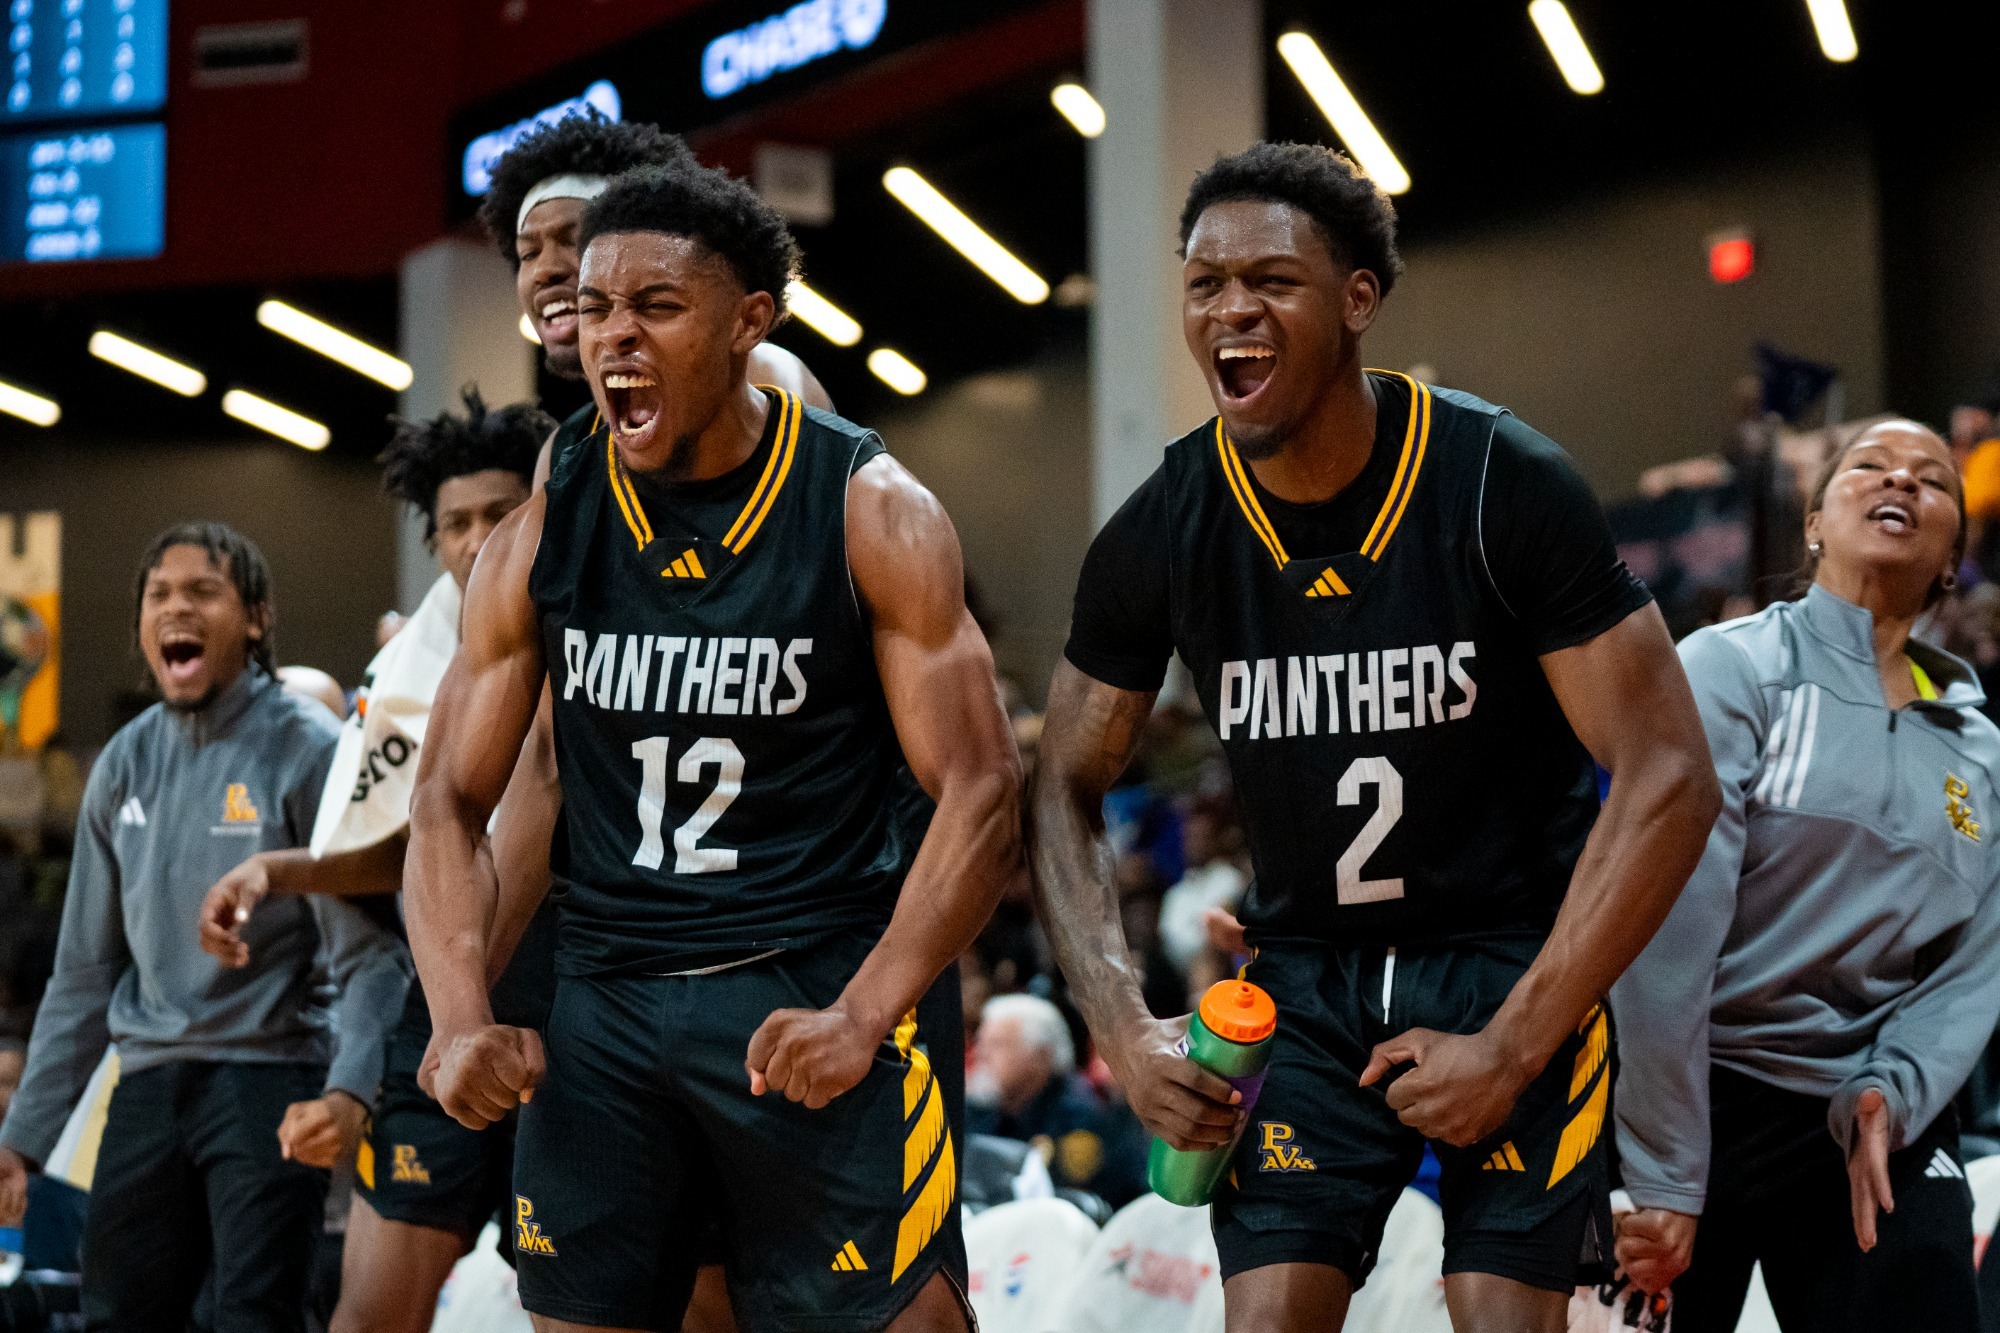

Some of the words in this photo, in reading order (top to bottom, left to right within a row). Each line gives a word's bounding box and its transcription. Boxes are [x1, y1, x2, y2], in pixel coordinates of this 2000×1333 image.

[563, 627, 814, 716] PANTHERS
[1219, 640, 1478, 740] PANTHERS
[631, 736, 746, 874] 12
[1336, 756, 1405, 905] 2
